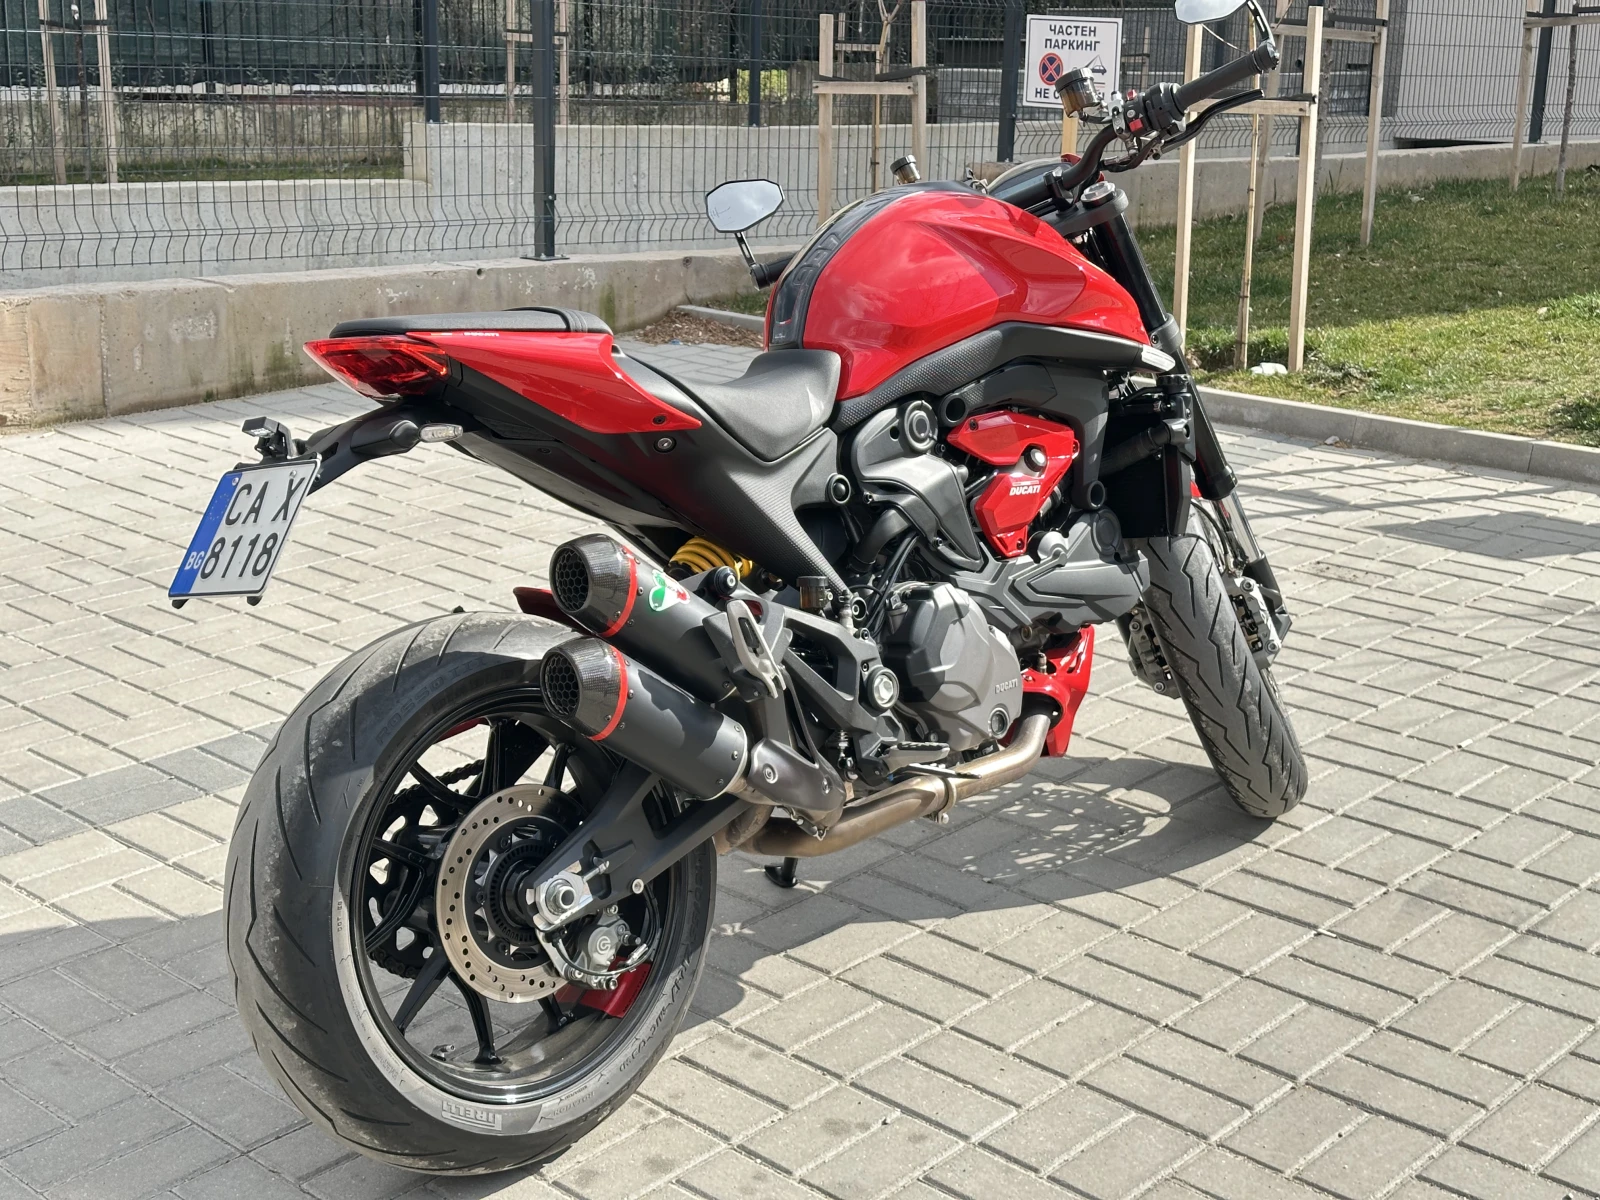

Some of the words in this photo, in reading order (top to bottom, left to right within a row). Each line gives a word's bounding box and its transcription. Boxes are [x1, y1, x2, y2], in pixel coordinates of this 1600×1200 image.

[1049, 24, 1097, 37] ЧАСТЕН
[1044, 38, 1101, 51] ПАРКИНГ
[1035, 87, 1050, 99] НЕ
[1009, 485, 1041, 496] DUCATI
[225, 481, 269, 526] CA
[271, 477, 305, 522] X
[184, 551, 205, 570] BG
[200, 532, 279, 580] 8118
[994, 678, 1018, 694] DUCATI
[441, 1099, 502, 1131] PIRELLI
